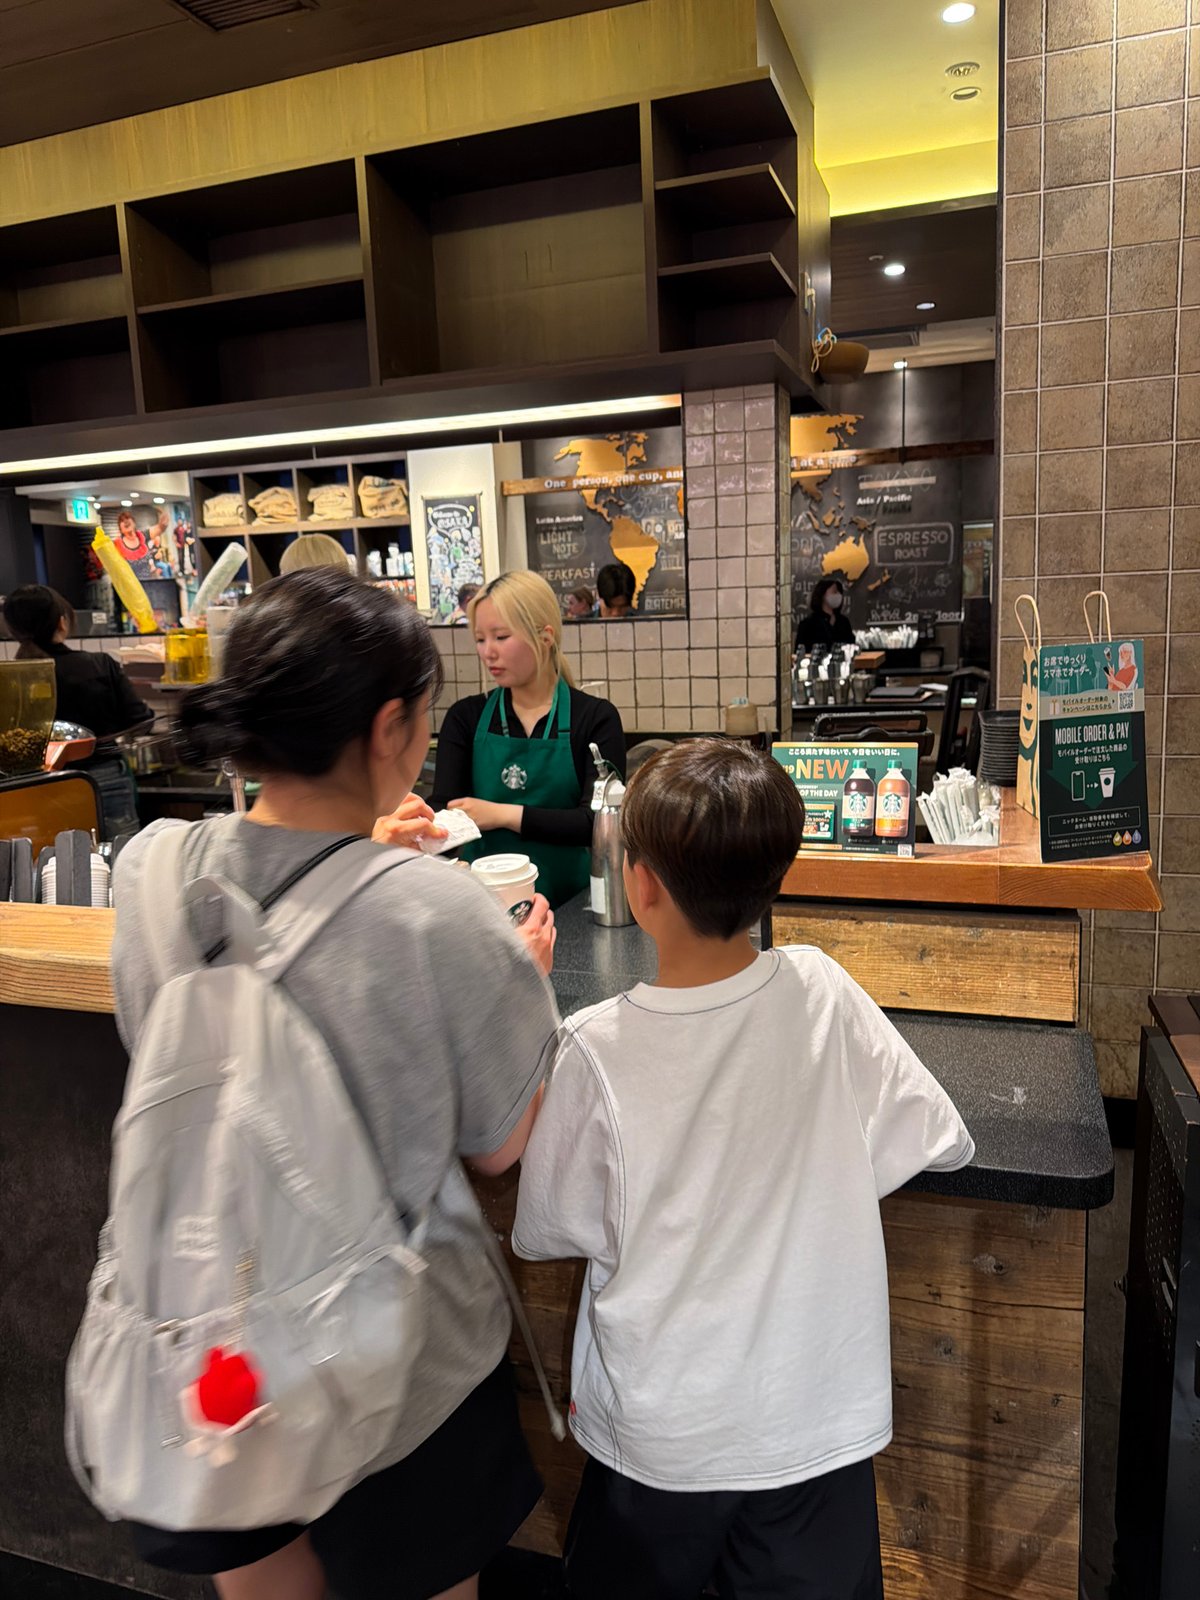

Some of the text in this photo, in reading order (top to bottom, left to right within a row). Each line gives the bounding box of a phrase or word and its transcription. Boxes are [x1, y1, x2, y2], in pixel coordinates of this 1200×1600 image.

[544, 479, 566, 489] One
[572, 474, 612, 489] person,
[615, 474, 635, 484] one
[639, 471, 663, 482] cup,
[857, 496, 874, 505] Asia
[883, 494, 912, 503] Pacific
[536, 514, 583, 525] Latin America
[540, 531, 573, 545] LIGHT
[878, 530, 948, 546] ESPRESSO
[552, 543, 579, 554] NOTE
[894, 548, 928, 560] ROAST
[1055, 721, 1129, 745] MOBILE ORDER & PAY
[796, 759, 849, 779] NEW
[800, 789, 838, 797] OF THE DAY
